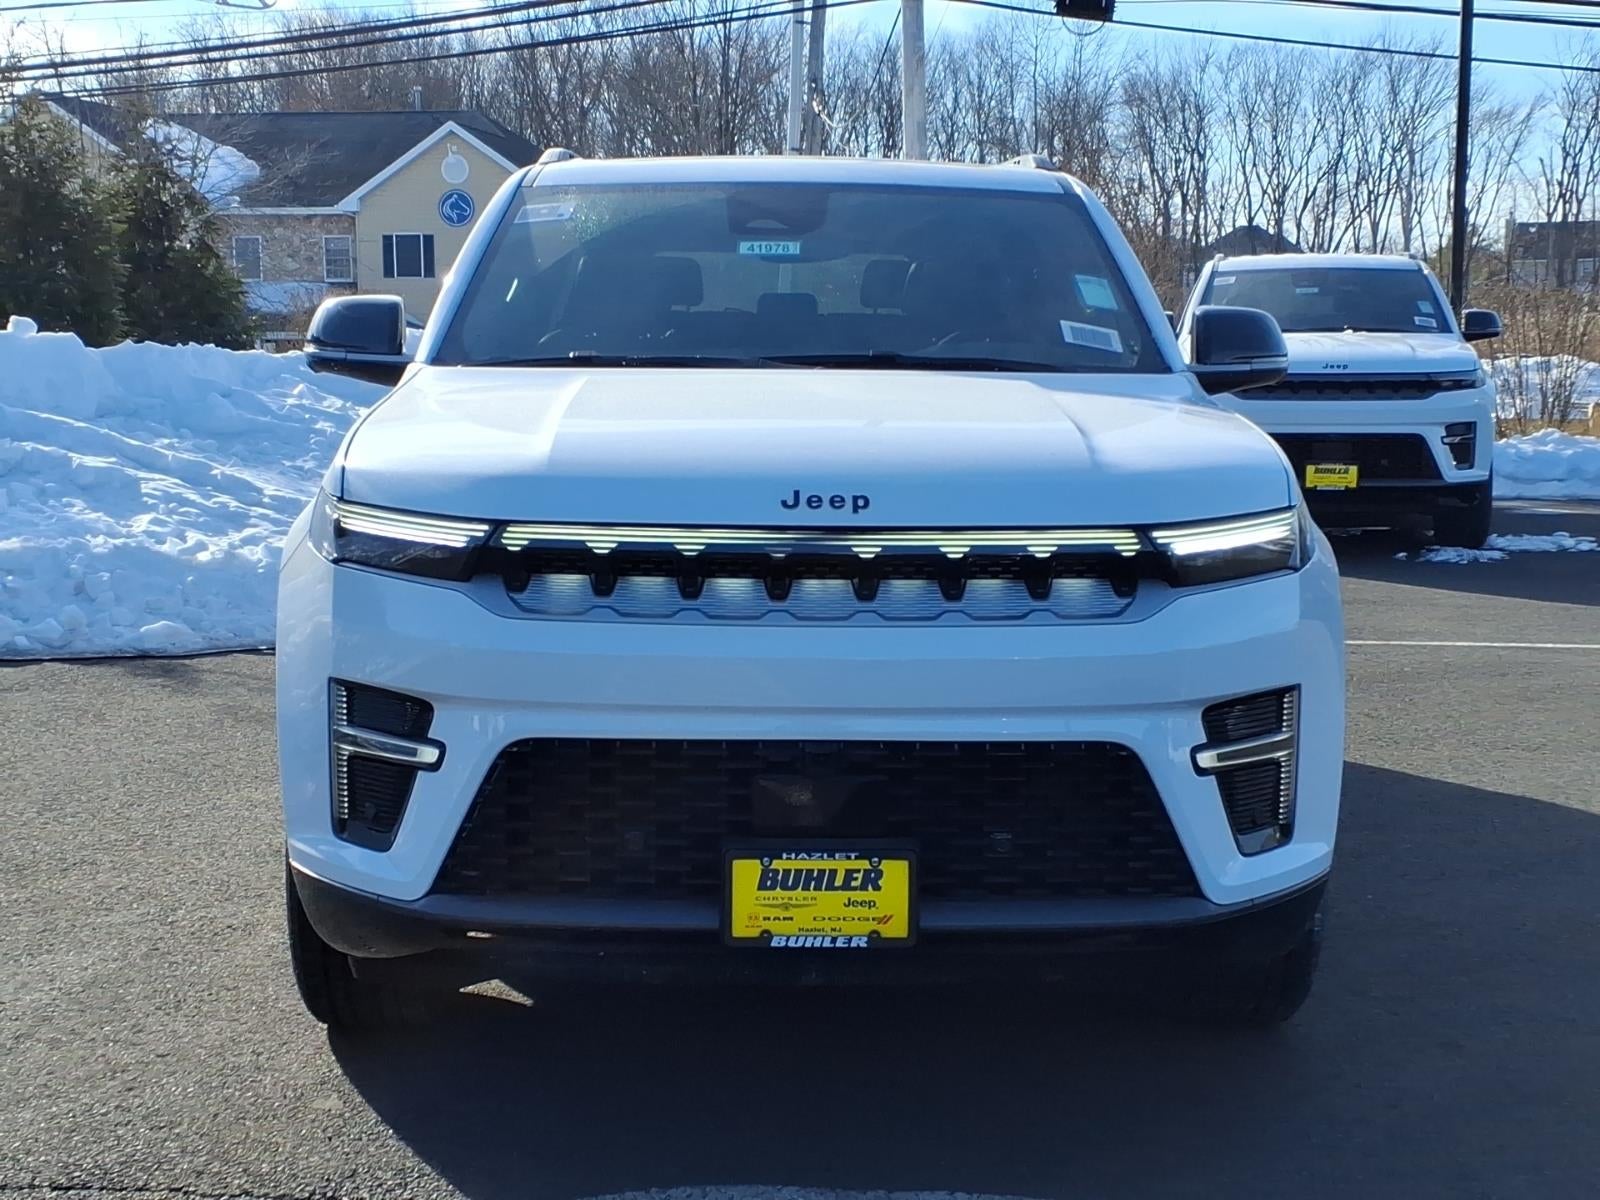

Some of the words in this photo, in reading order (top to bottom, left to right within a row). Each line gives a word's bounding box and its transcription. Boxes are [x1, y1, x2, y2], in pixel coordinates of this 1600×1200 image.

[746, 243, 790, 253] 41978
[780, 489, 870, 514] Jeep
[782, 852, 859, 860] HAZLET
[757, 868, 883, 892] BUHLER
[843, 897, 876, 909] Jeep
[770, 936, 868, 947] BUHLER
